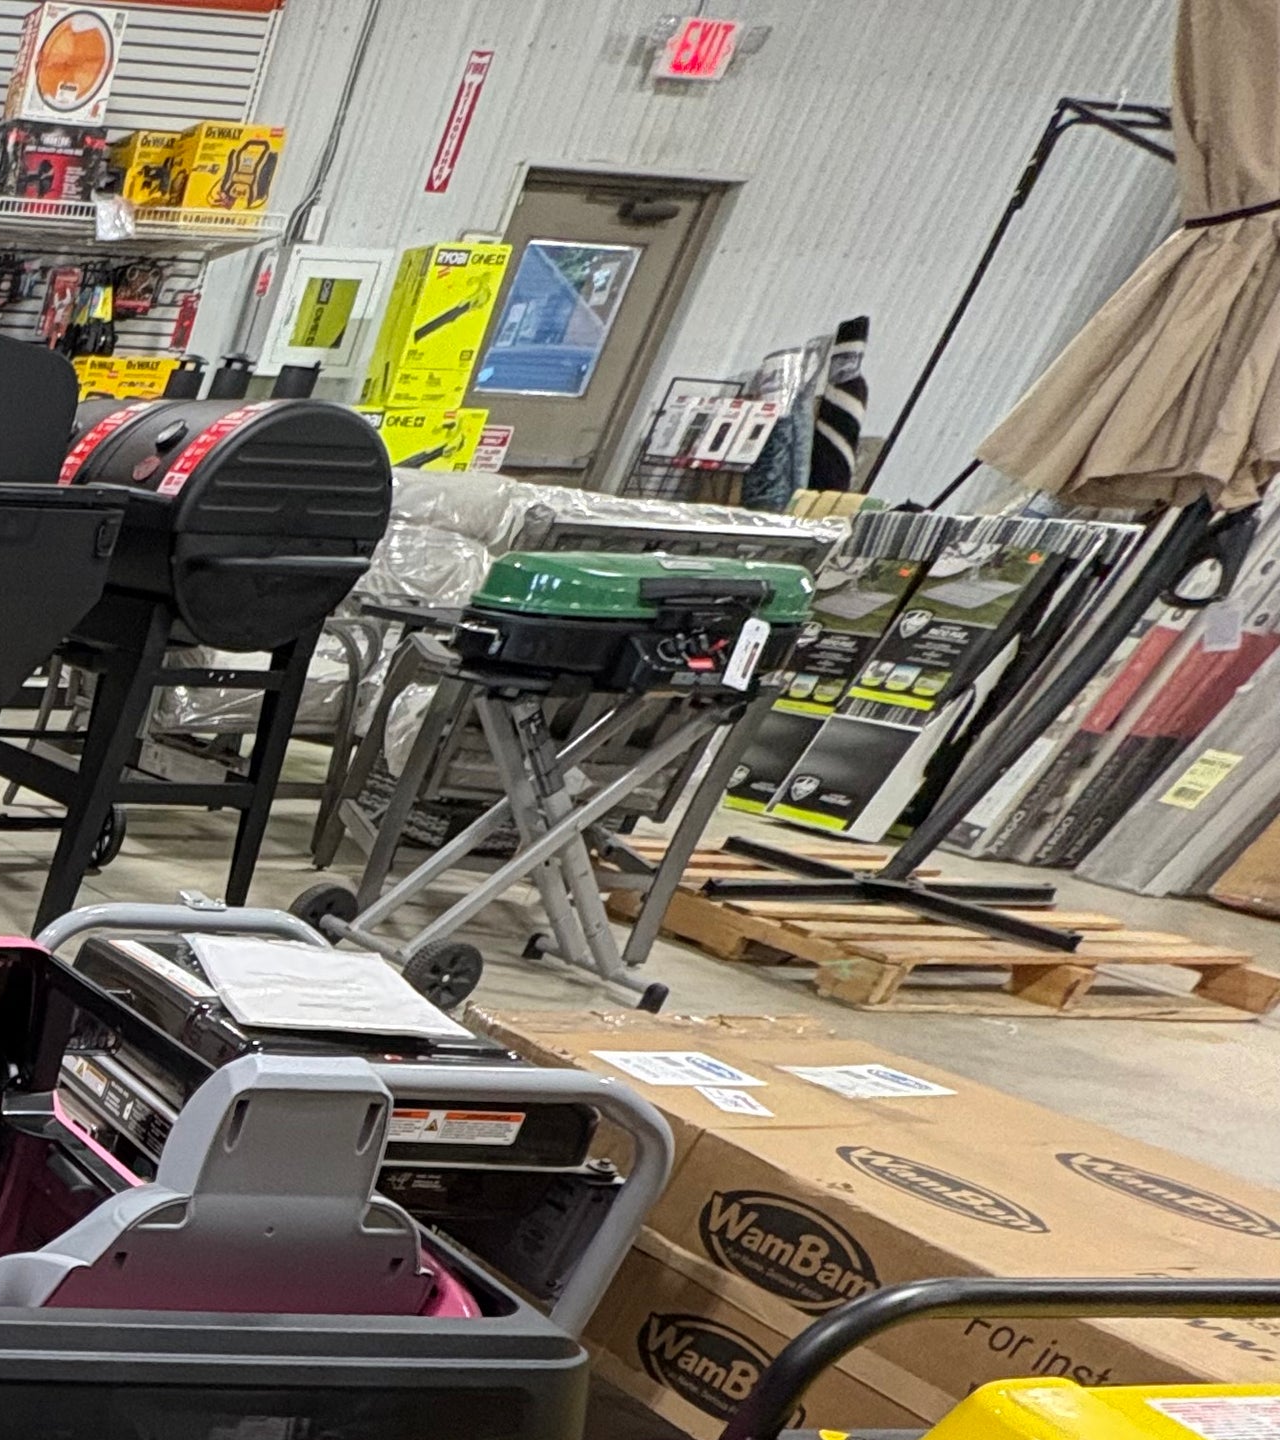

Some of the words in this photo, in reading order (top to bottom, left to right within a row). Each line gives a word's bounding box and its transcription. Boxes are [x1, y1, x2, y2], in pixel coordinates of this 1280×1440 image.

[669, 20, 736, 76] EXIT
[437, 251, 469, 265] RYOBI
[849, 1147, 1047, 1234] WamBam
[708, 1194, 876, 1300] WamBam
[648, 1316, 760, 1400] WamB
